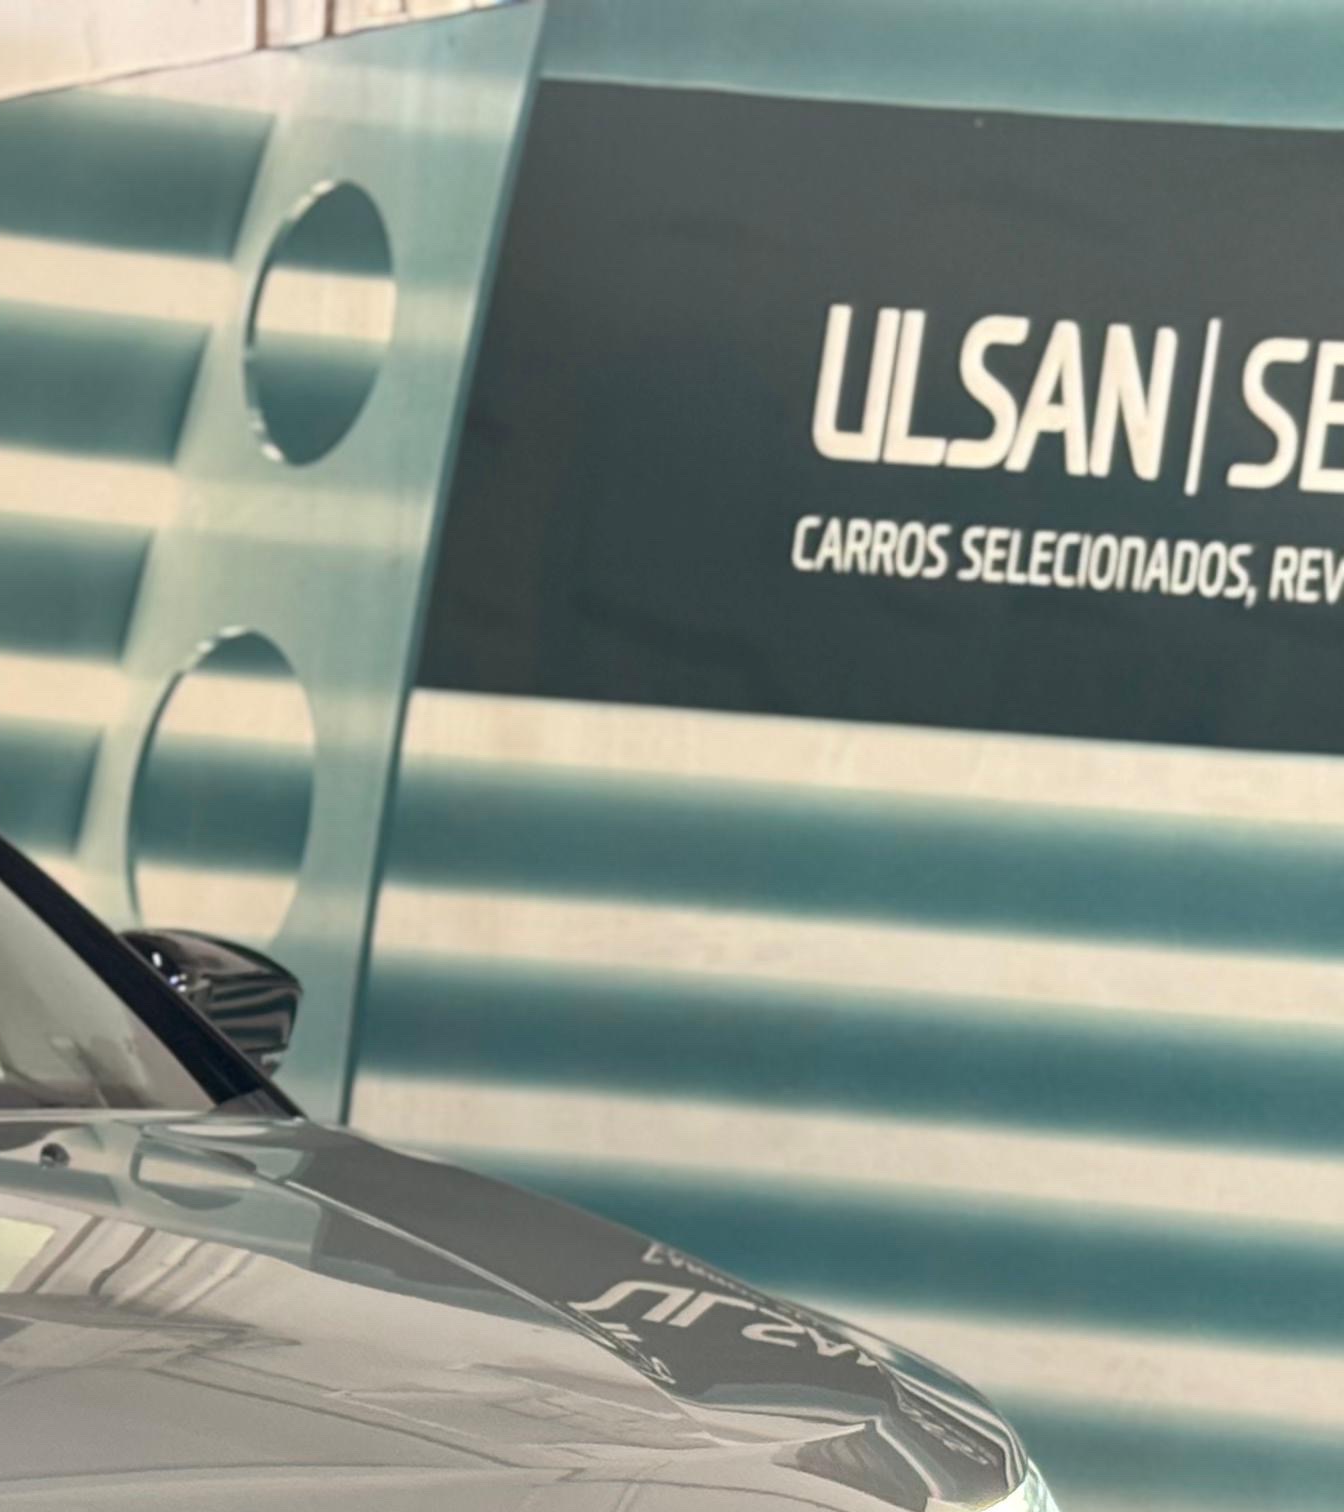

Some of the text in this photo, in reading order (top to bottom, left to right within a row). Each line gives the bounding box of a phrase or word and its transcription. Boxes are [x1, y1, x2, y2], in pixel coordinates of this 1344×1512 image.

[813, 304, 1344, 493] ULSAN SE
[791, 514, 952, 581] CARROS
[957, 525, 1258, 609] SELECIONADOS,
